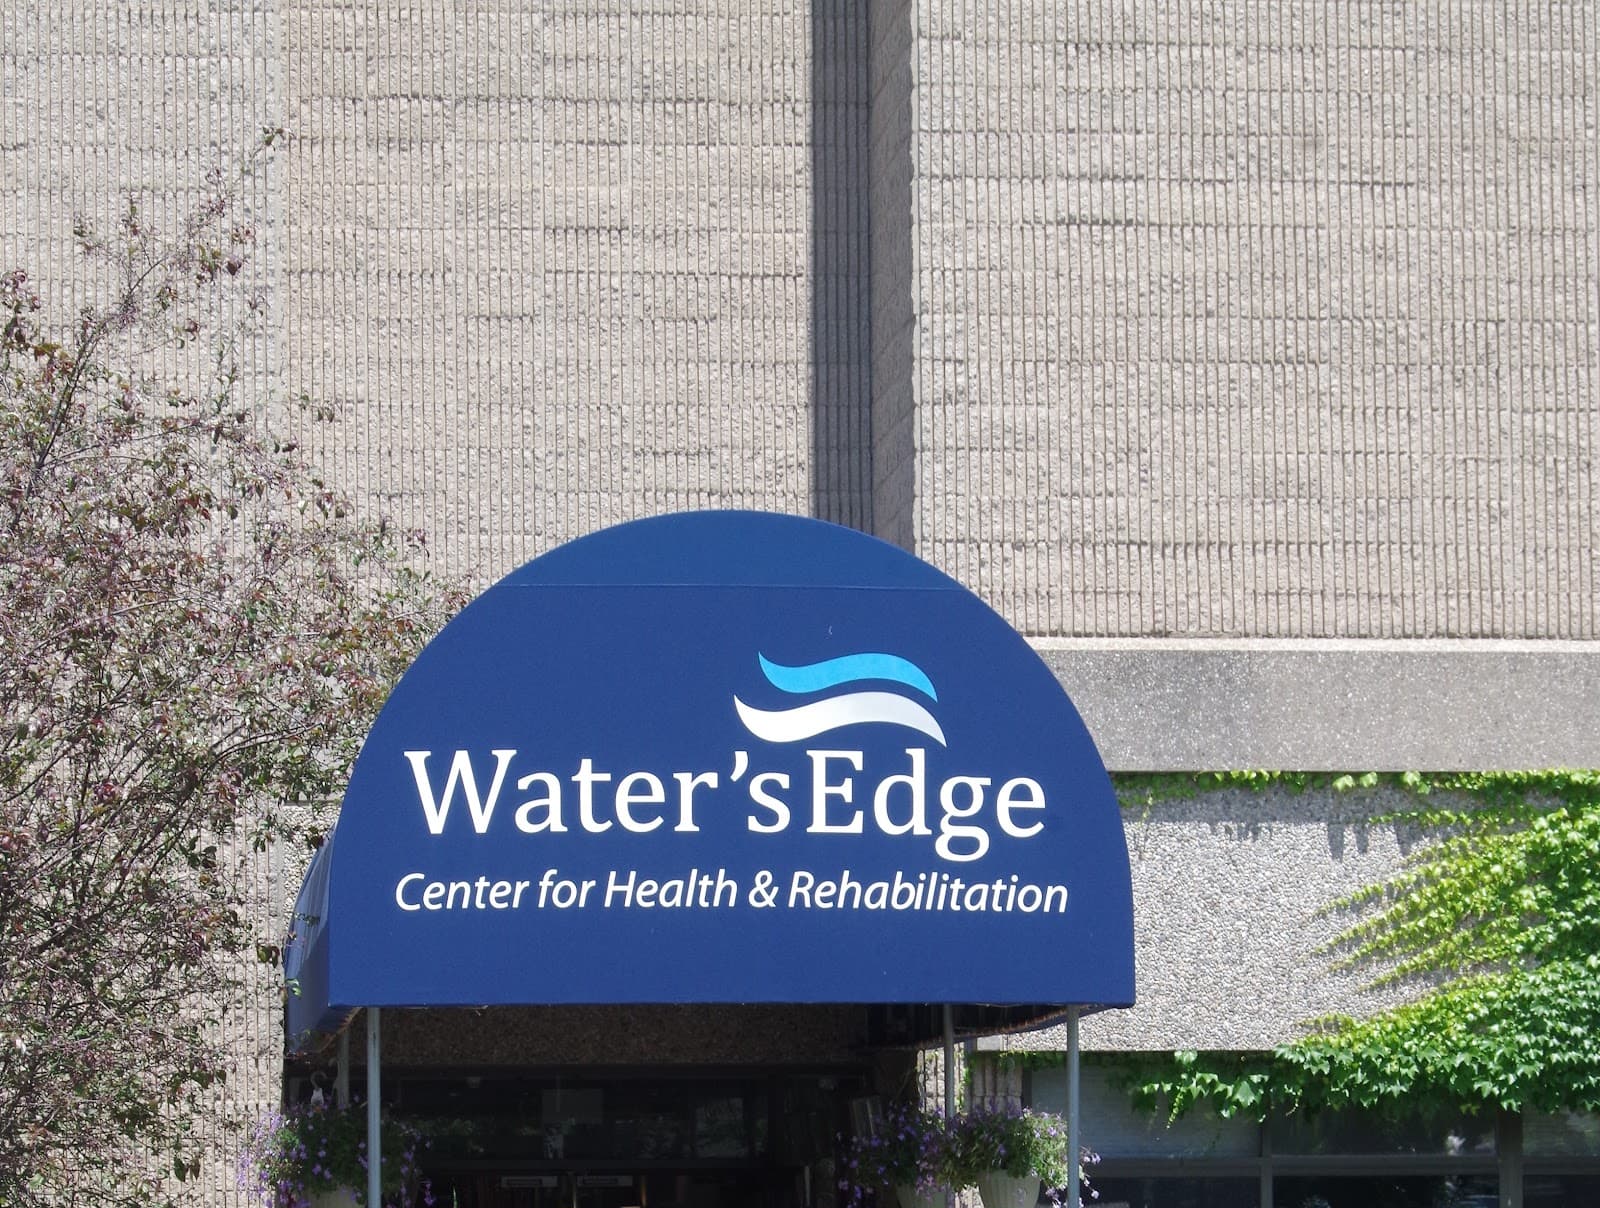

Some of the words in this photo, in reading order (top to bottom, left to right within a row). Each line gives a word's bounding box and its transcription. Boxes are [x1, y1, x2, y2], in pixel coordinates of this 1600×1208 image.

[806, 746, 1047, 863] Edge
[396, 872, 530, 911] Center
[536, 868, 597, 909] for
[603, 869, 738, 910] Health
[748, 870, 780, 910] &
[787, 870, 1068, 913] Rehabilitation
